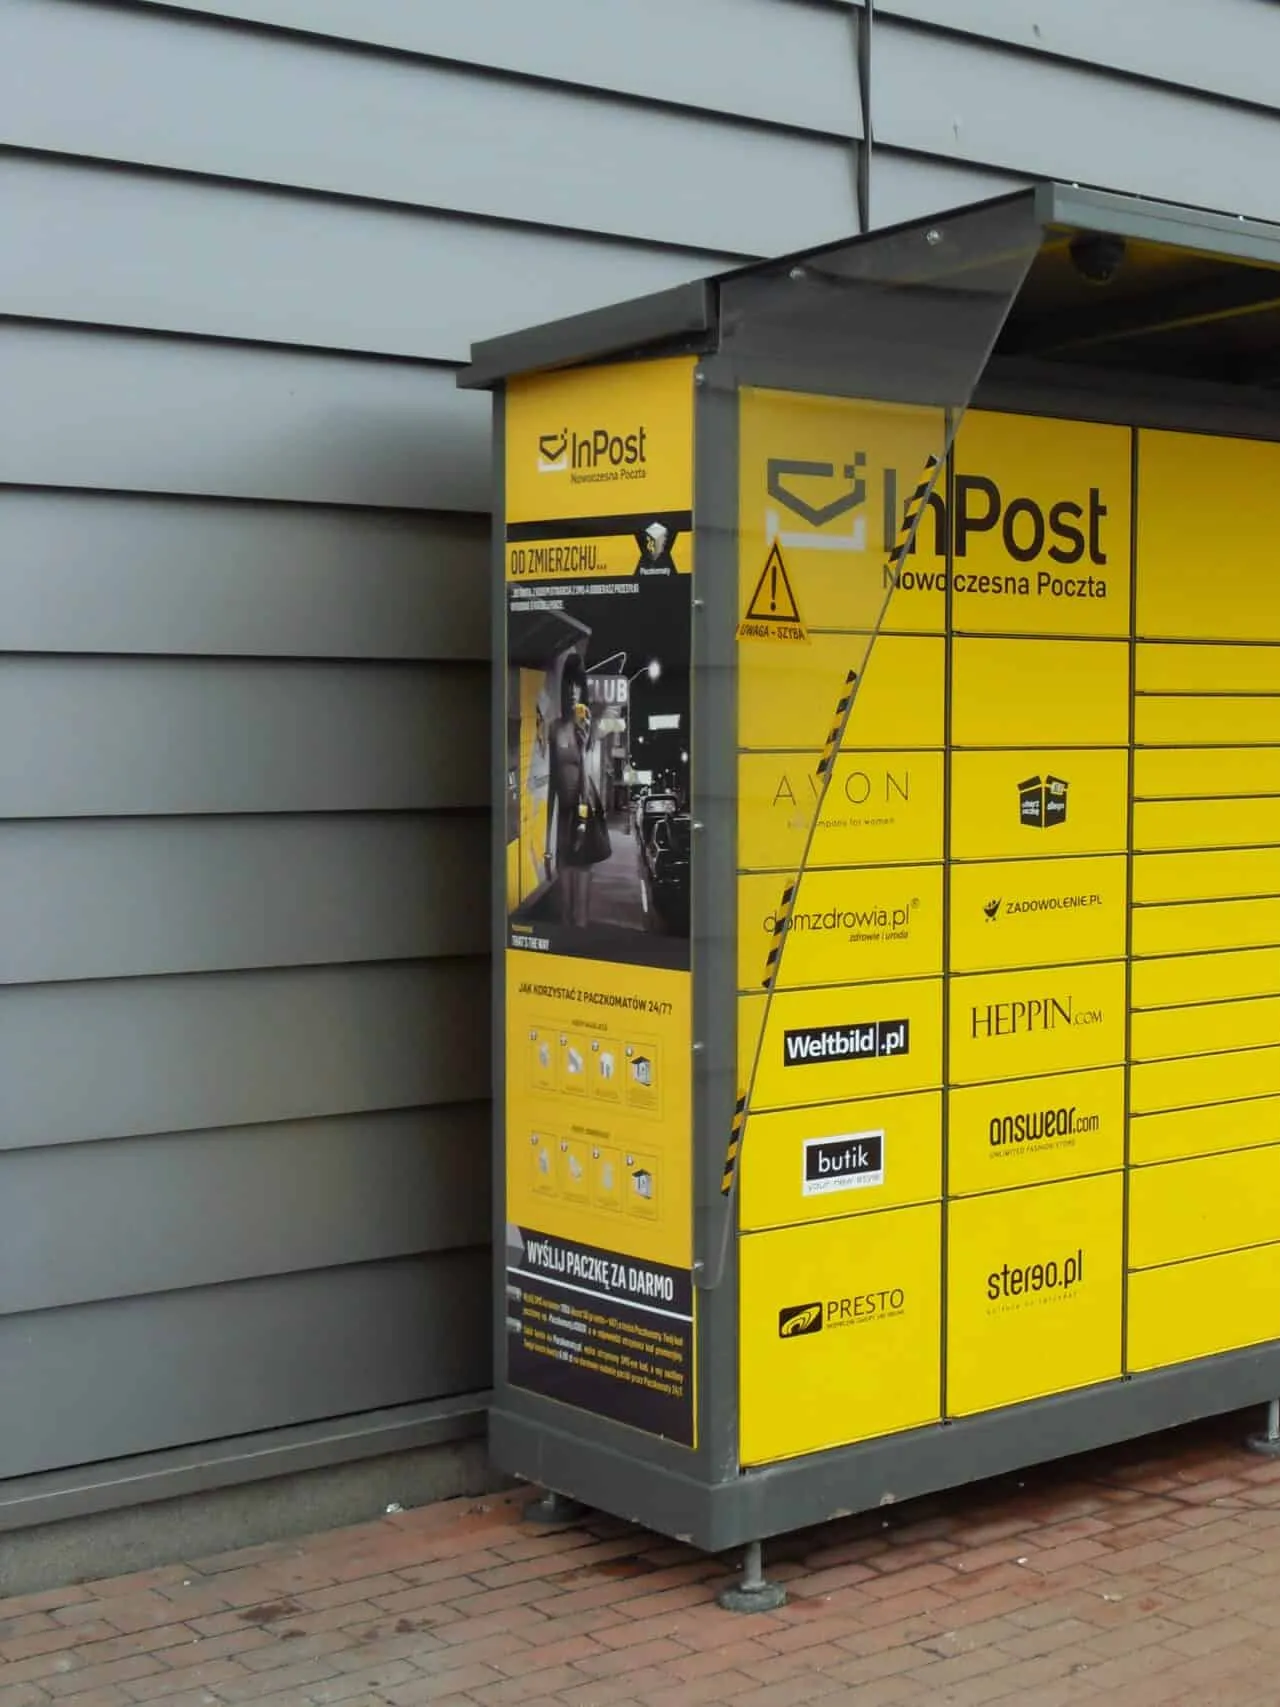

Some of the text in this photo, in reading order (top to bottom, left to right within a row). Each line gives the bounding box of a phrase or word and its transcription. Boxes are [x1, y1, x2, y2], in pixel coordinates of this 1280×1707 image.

[570, 426, 647, 469] InPost
[571, 468, 647, 485] Nowoczesna Poczta
[884, 469, 1107, 566] InPost
[511, 549, 526, 575] OD
[884, 564, 1107, 598] Nowoczesna Poczta
[773, 771, 909, 806] AVON
[519, 983, 531, 993] JAK
[577, 990, 582, 1002] Z
[584, 991, 646, 1011] PACZKOMATÓW
[990, 1107, 1099, 1146] answear.com
[818, 1144, 869, 1173] butik
[527, 1239, 674, 1301] WYŚLIJ PACZKĘ ZA DARMO
[988, 1249, 1082, 1300] stereo.pl
[827, 1288, 905, 1320] PRESTO
